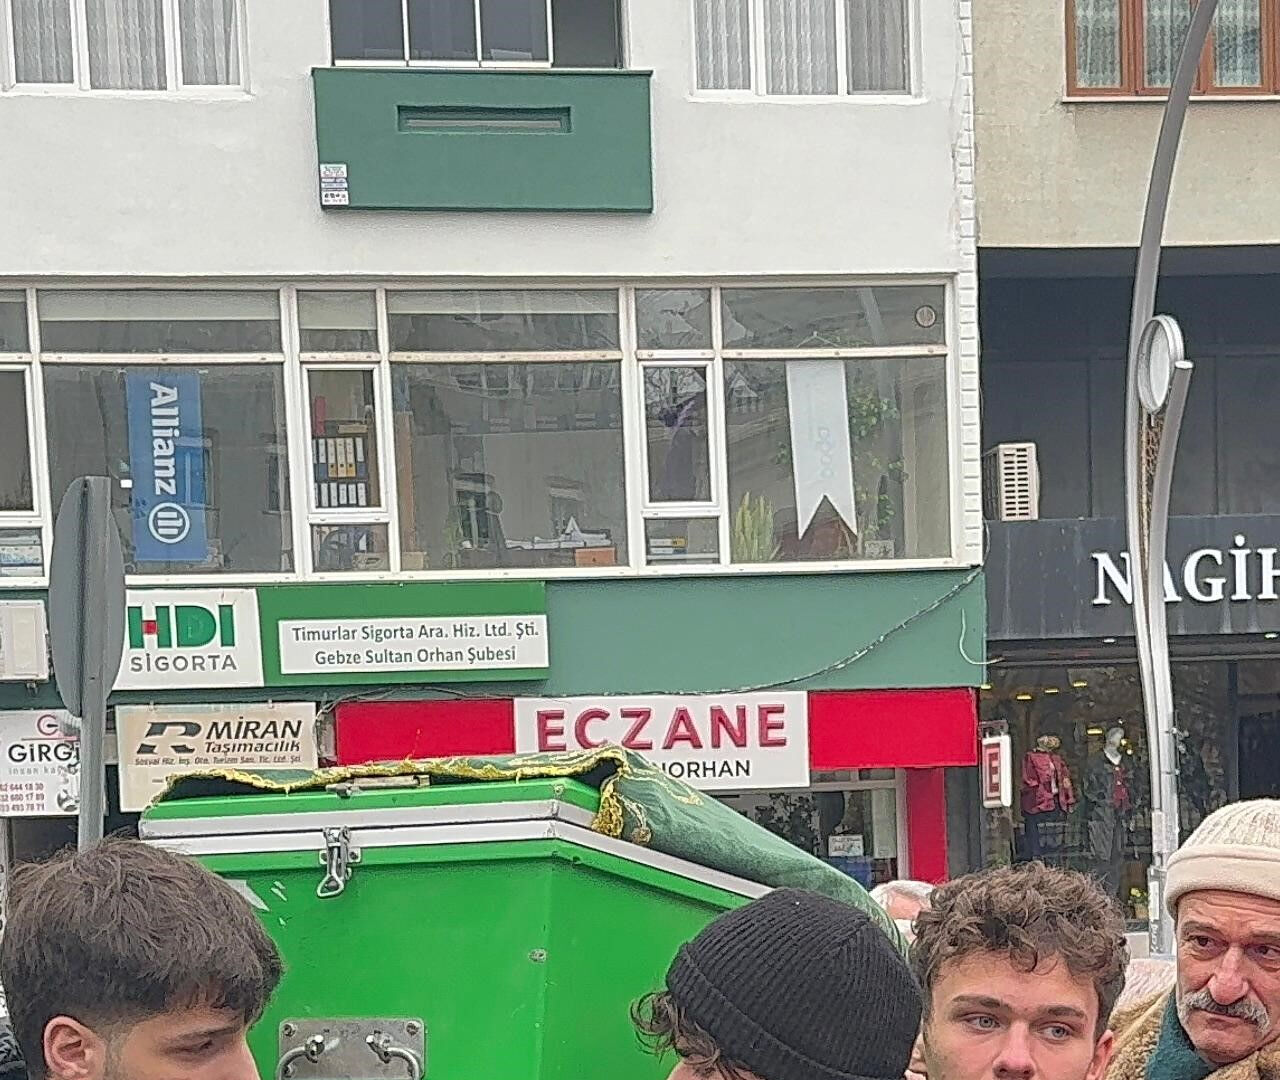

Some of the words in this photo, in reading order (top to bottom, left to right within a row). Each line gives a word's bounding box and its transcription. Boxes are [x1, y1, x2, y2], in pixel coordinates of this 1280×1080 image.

[150, 382, 179, 496] Allianz
[128, 604, 235, 649] HDI
[292, 627, 357, 641] Timurlar
[362, 625, 414, 644] Sigorta
[419, 624, 448, 639] Ara.
[453, 624, 480, 638] Hiz.
[484, 623, 512, 637] Ltd.
[515, 622, 539, 639] Şti.
[130, 652, 237, 673] SİGORTA
[315, 650, 361, 665] Gebze
[365, 649, 413, 664] Sultan
[417, 648, 464, 662] Orhan
[467, 646, 516, 664] Şubesi
[206, 717, 302, 740] MİRAN
[536, 703, 788, 752] ECZANE
[205, 741, 300, 757] Taşımacılık
